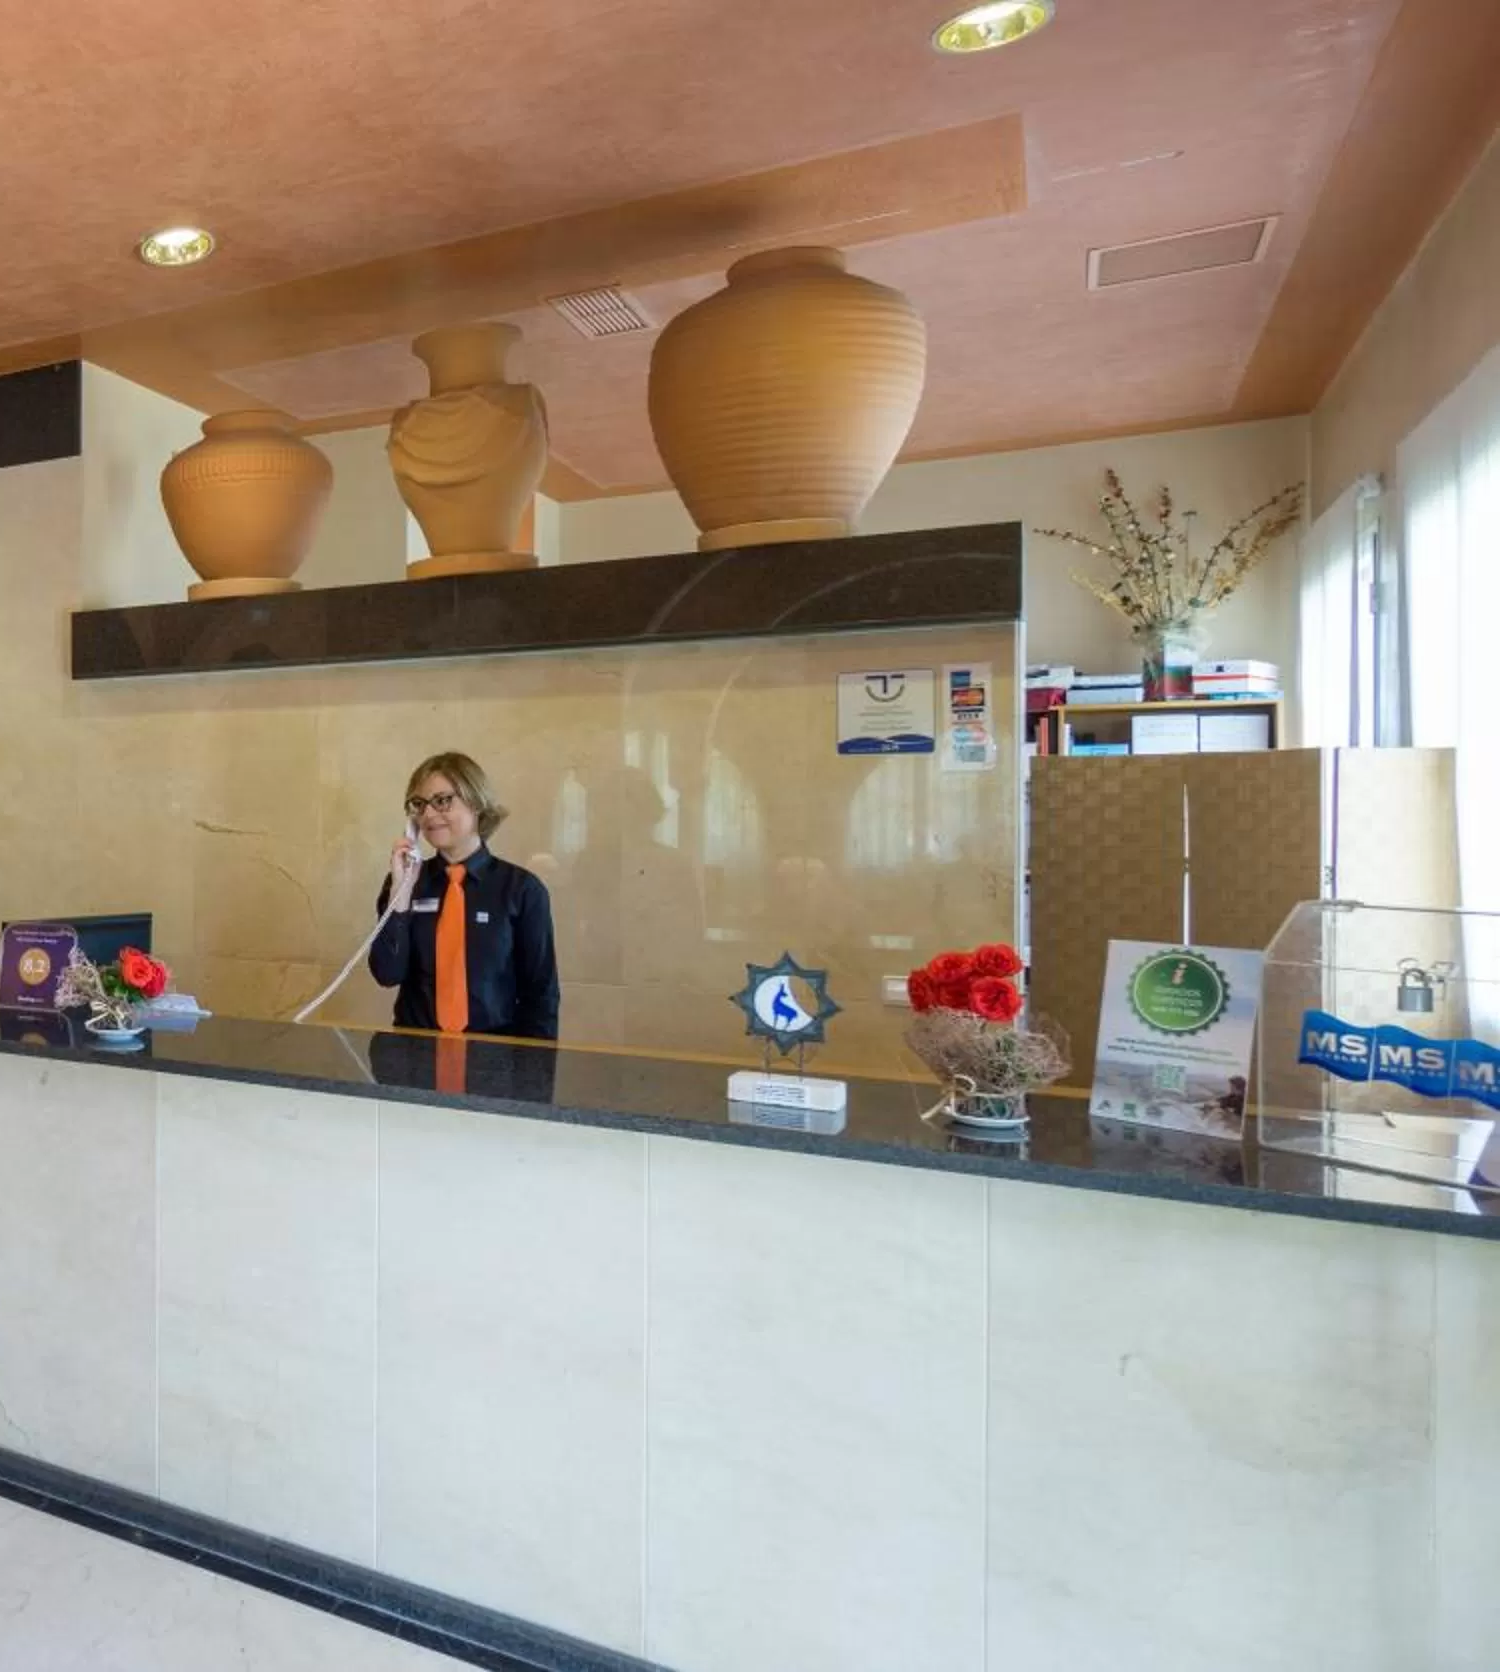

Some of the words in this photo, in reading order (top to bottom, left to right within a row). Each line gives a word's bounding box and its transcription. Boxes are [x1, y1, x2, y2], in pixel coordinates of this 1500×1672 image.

[1306, 1030, 1368, 1057] MS
[1379, 1045, 1445, 1070] MS
[1457, 1061, 1500, 1085] M
